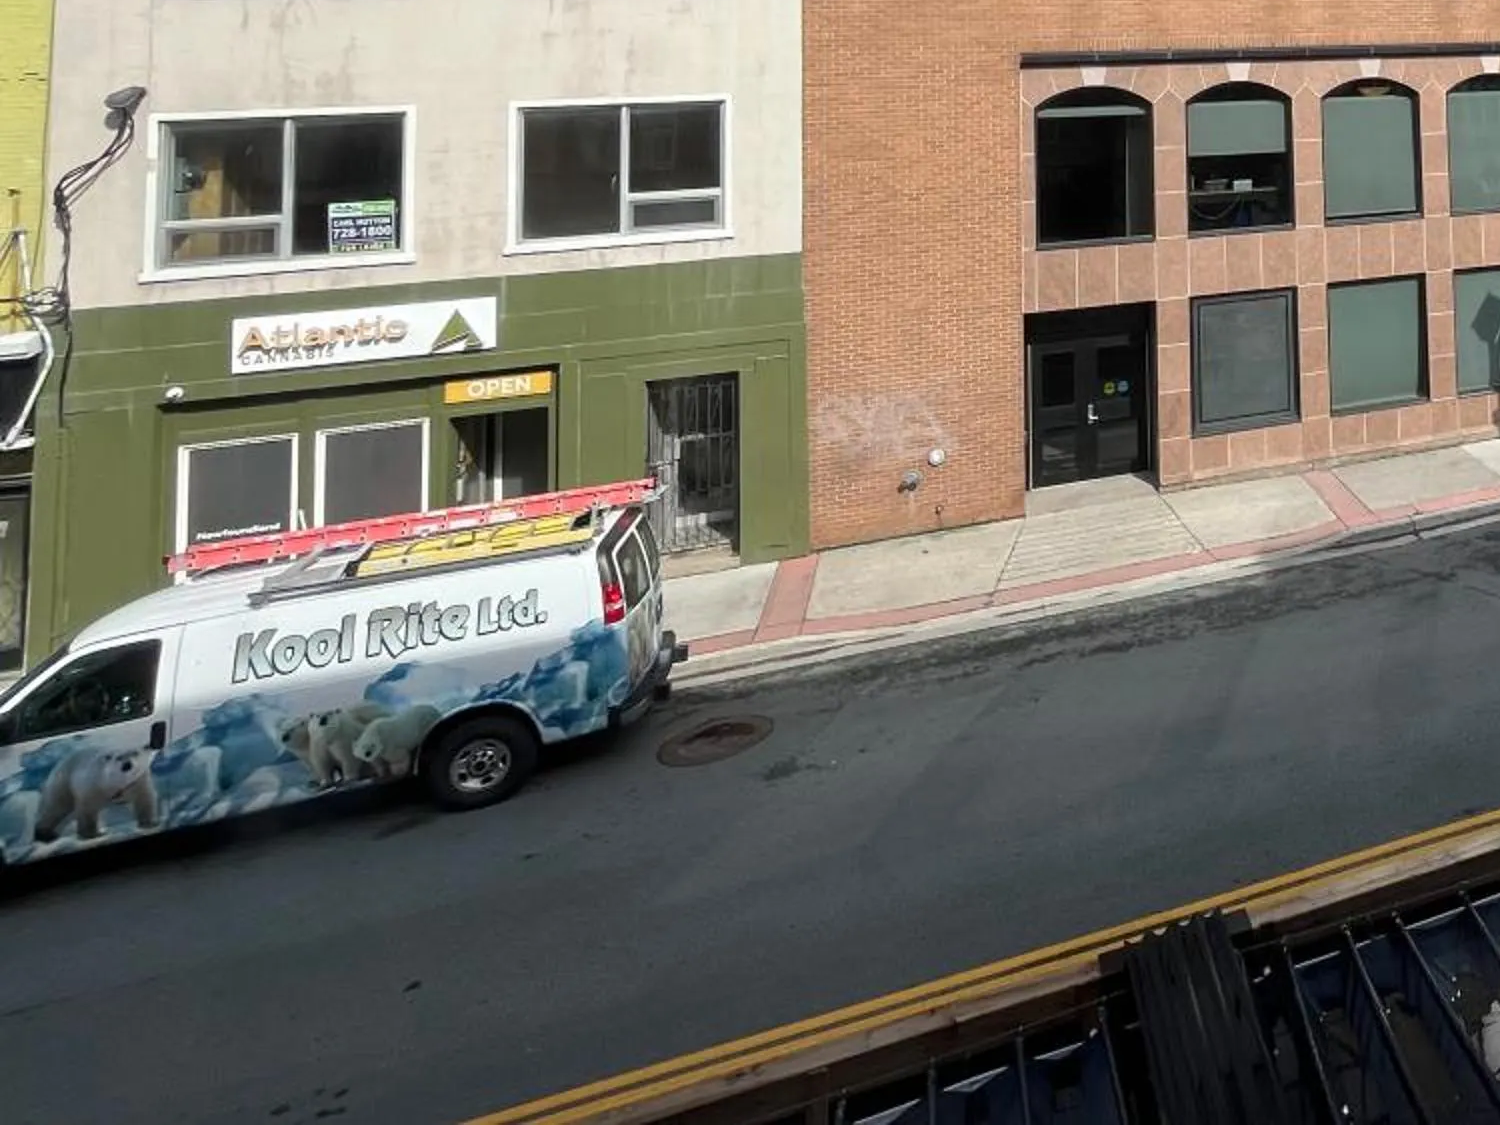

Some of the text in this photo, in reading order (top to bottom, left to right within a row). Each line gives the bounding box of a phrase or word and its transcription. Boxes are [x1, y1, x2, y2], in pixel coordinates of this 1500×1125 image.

[240, 315, 408, 351] Atlantic
[241, 347, 335, 365] CANNABIS
[467, 375, 533, 397] OPEN
[231, 588, 549, 683] Kool Rite Ltd.
